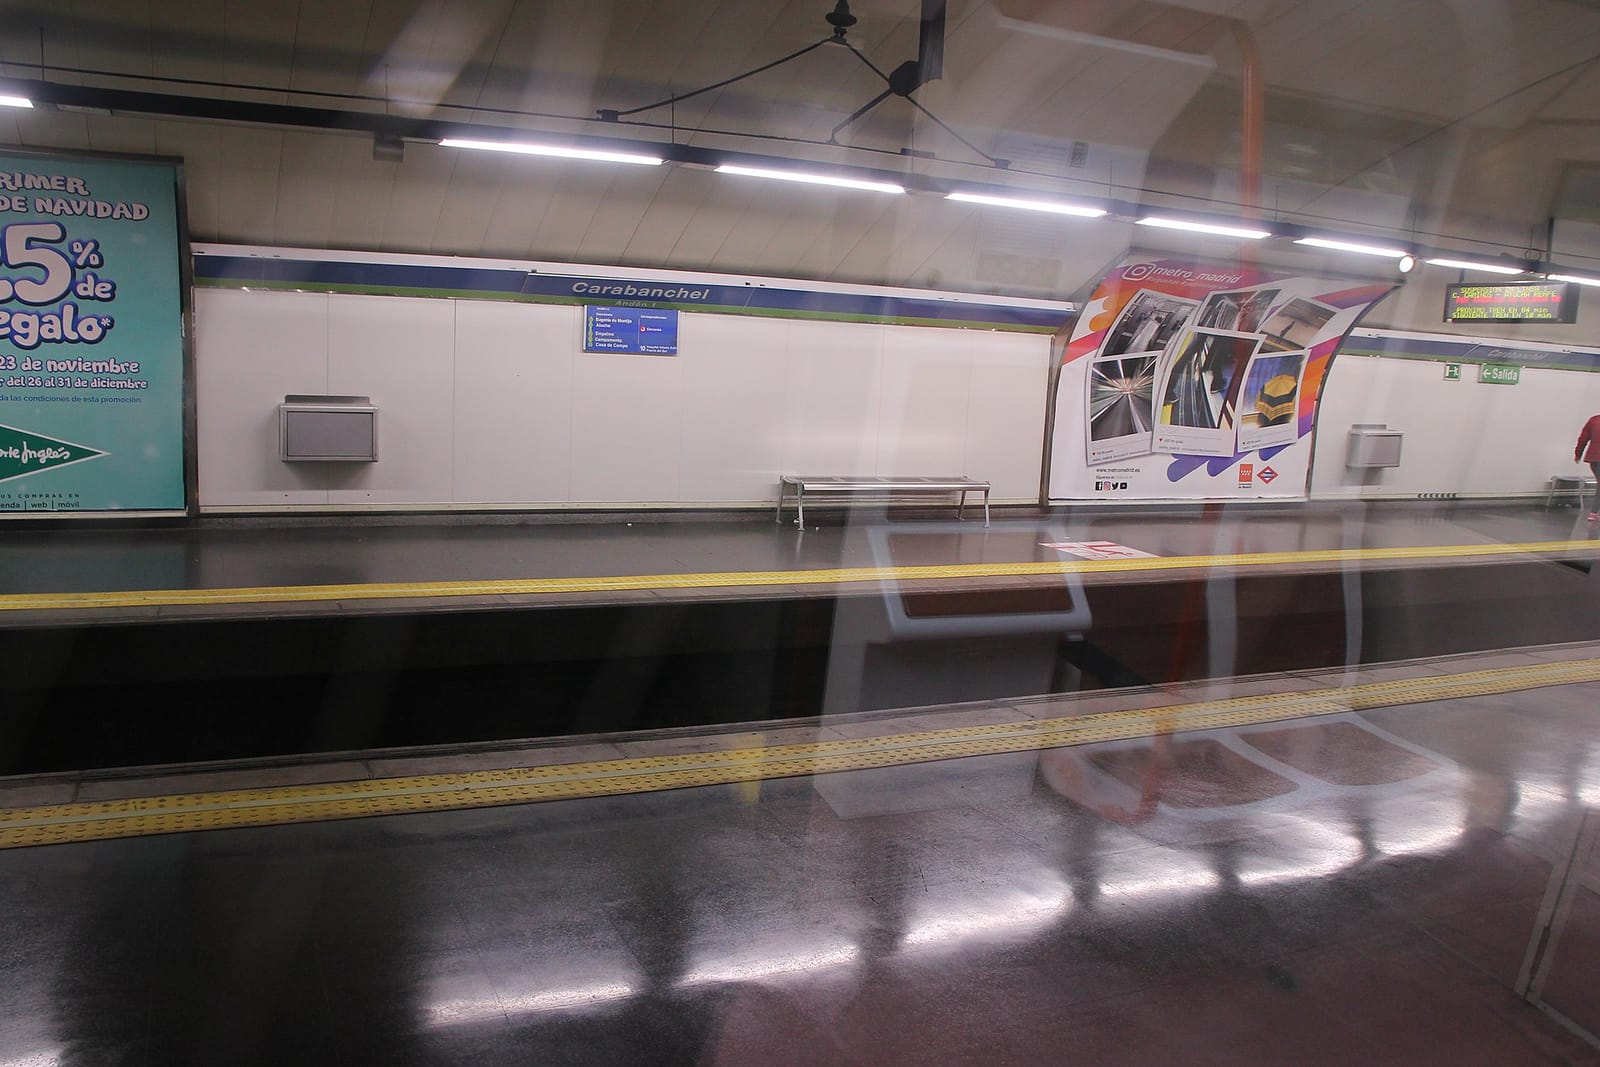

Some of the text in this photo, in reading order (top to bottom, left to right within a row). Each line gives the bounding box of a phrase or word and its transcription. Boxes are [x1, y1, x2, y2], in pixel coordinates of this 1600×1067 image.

[35, 197, 149, 220] NAVIDAD
[1154, 266, 1242, 284] metro_madrid
[75, 273, 115, 300] de
[572, 282, 710, 300] Carabanchel
[21, 356, 42, 371] de
[46, 356, 140, 374] noviembre
[6, 375, 26, 387] del
[27, 376, 43, 387] 26
[44, 376, 56, 388] al
[57, 376, 72, 388] 31
[74, 377, 88, 388] de
[90, 377, 148, 389] diciembre
[1492, 368, 1518, 381] Salida
